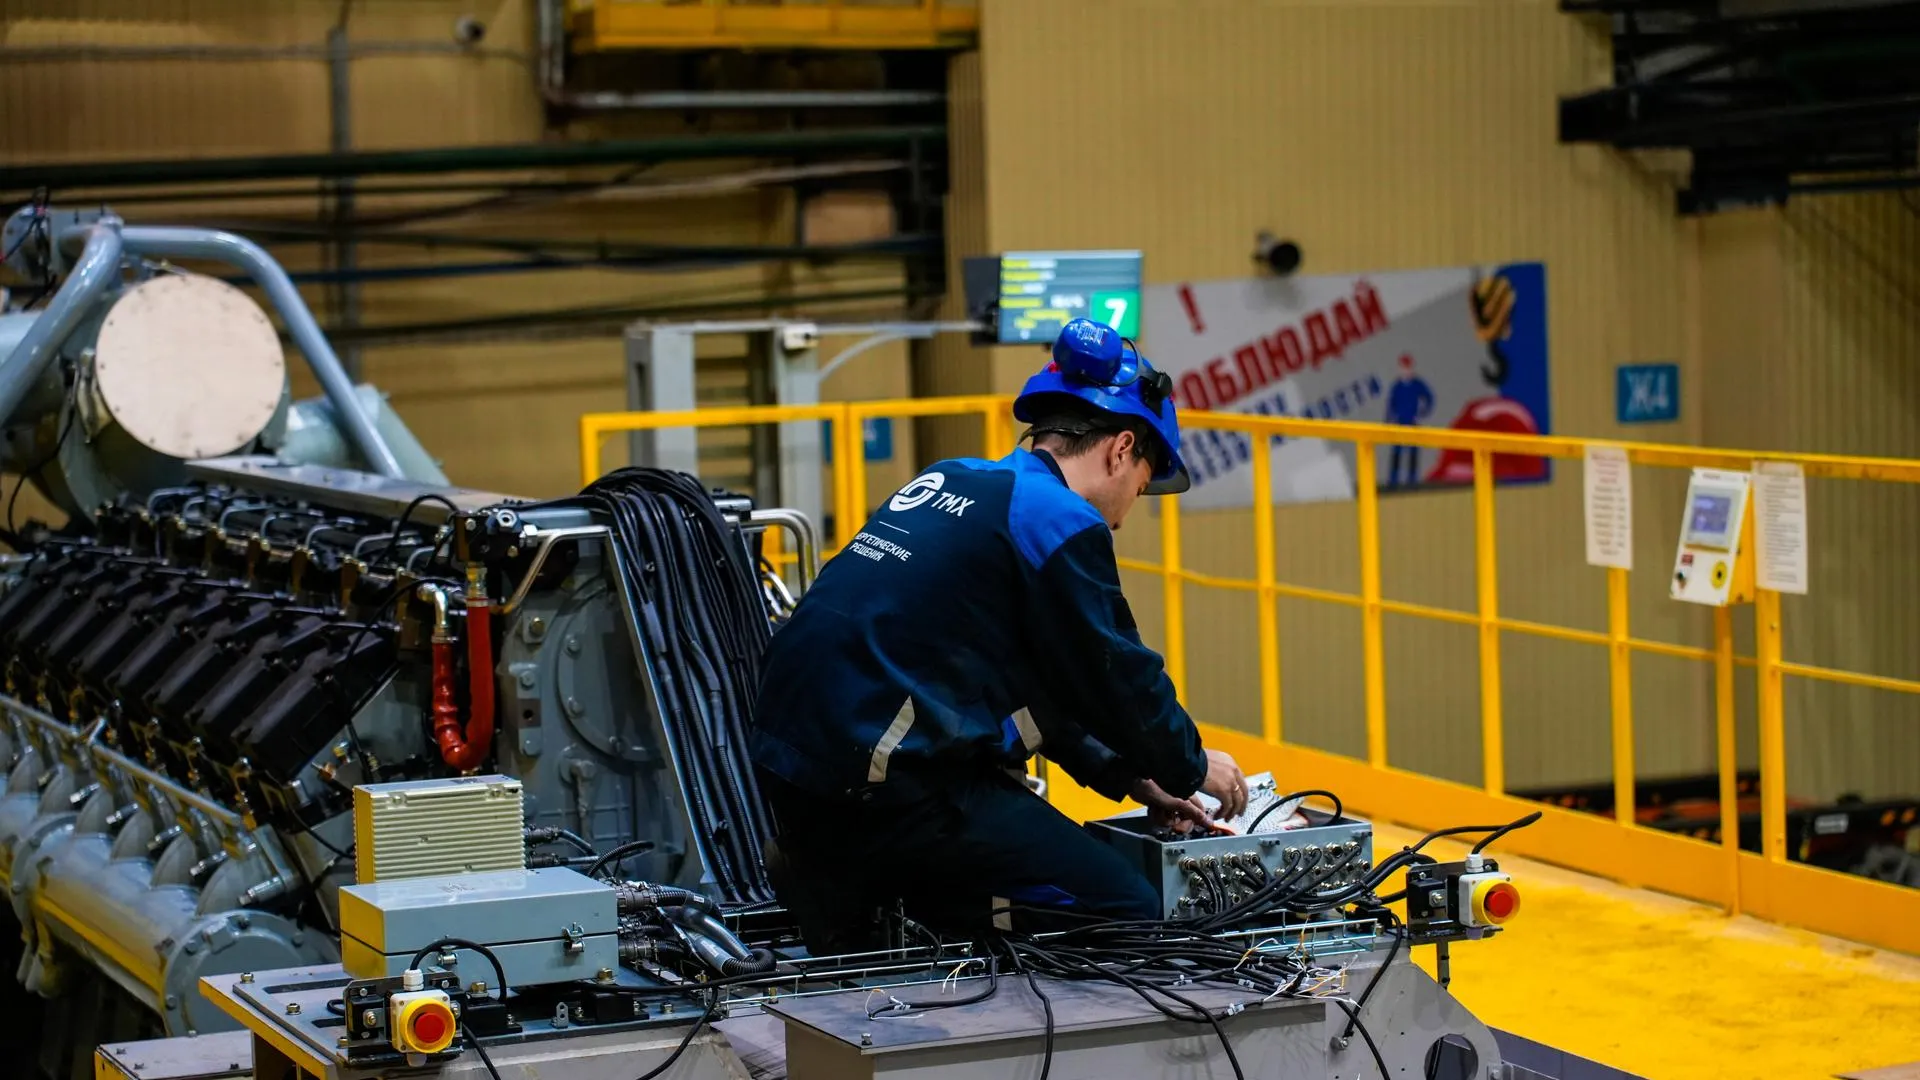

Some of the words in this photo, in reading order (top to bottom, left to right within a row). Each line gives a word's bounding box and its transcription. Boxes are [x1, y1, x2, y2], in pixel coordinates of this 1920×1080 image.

[1104, 297, 1128, 333] 7
[1171, 278, 1389, 412] ОБЛЮДАЙ
[849, 542, 885, 562] РЕШЕНИЯ
